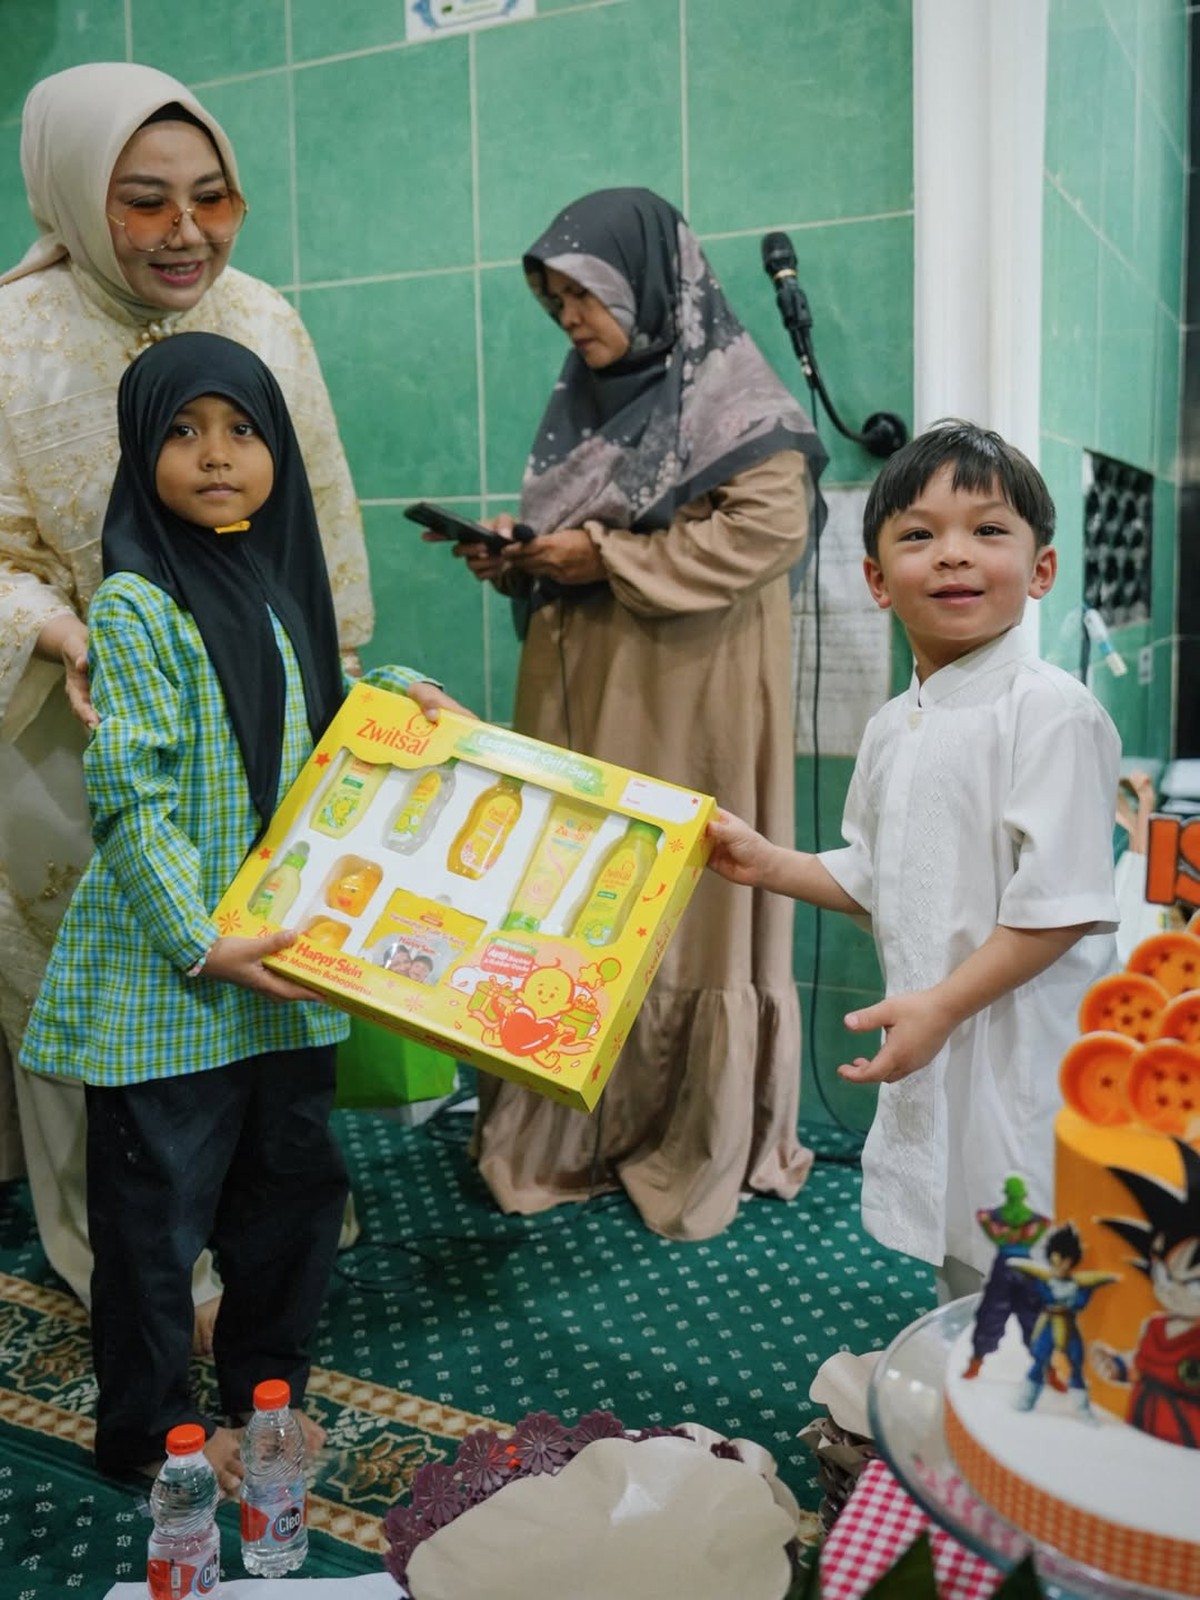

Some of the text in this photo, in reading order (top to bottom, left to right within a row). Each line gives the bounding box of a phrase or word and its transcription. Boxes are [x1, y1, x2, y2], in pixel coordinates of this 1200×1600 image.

[356, 718, 431, 757] Zwitsal
[289, 956, 322, 977] Momen
[295, 941, 364, 979] Happy Skin
[278, 1512, 301, 1534] Cleo
